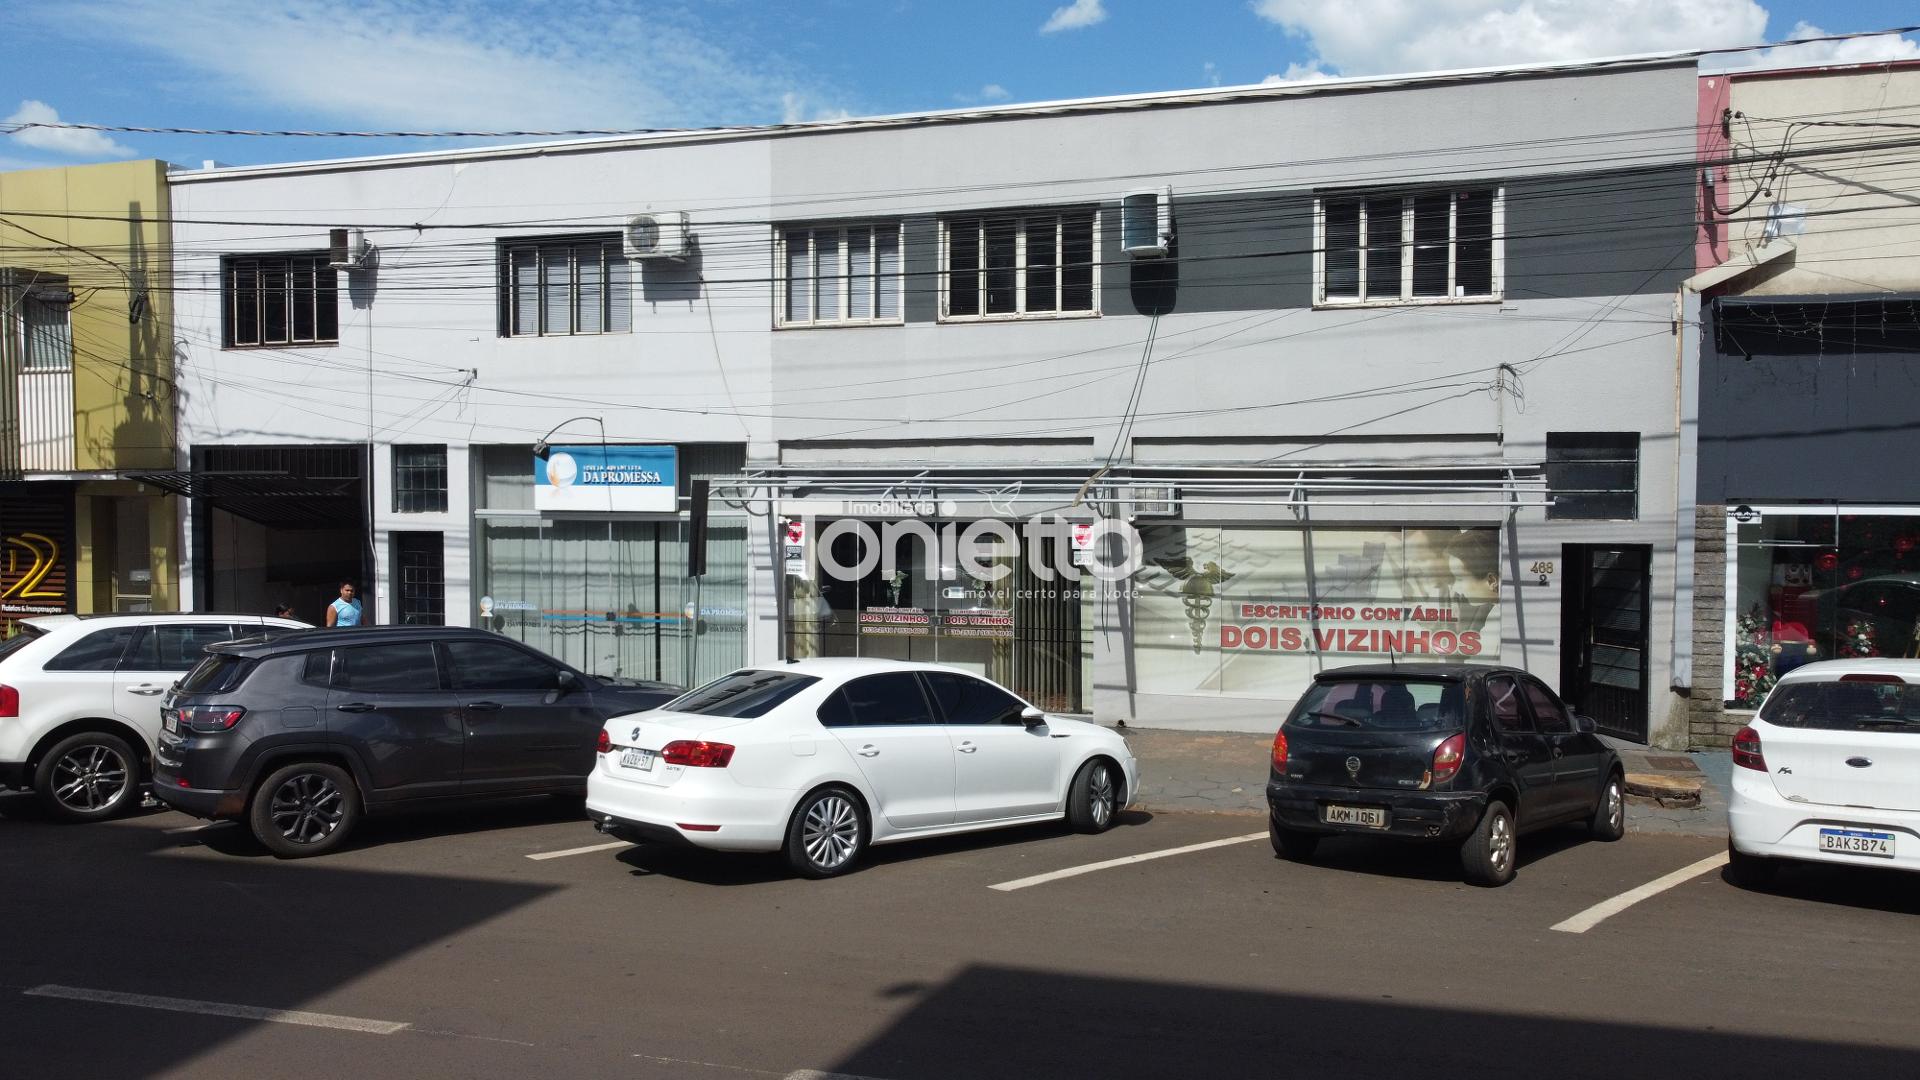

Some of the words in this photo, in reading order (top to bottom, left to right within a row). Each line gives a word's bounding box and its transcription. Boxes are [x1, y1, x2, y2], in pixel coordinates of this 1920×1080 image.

[583, 472, 600, 484] DA
[601, 472, 662, 484] PROMESSA
[884, 615, 929, 624] VIZINHOS
[1241, 604, 1355, 621] ESCRITÓRIO
[945, 617, 967, 625] DOIS
[969, 617, 1014, 626] VIZINHOS
[1221, 626, 1301, 651] DOIS
[1313, 628, 1483, 655] VIZINHOS
[1826, 836, 1887, 853] BAK3B74
